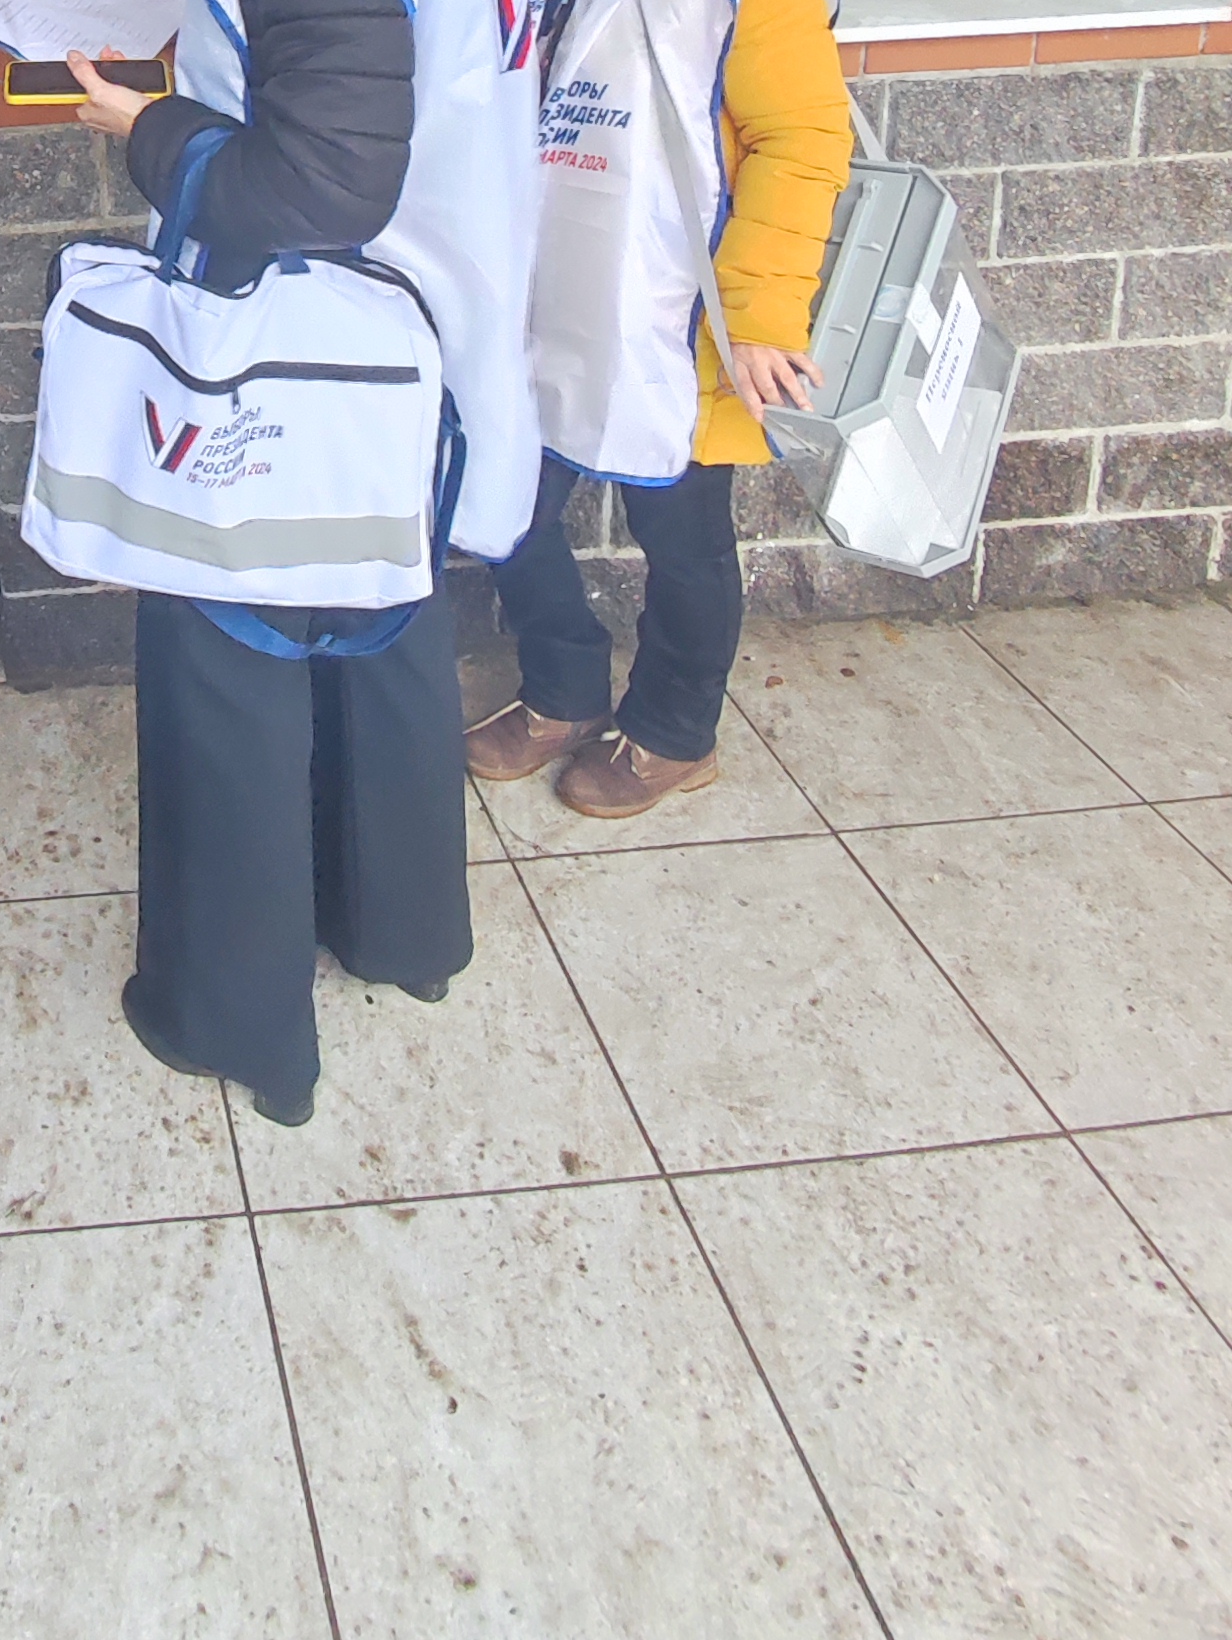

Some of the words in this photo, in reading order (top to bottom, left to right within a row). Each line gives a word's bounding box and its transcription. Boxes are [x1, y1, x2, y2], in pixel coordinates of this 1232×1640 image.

[548, 80, 609, 103] ВОРЫ
[538, 103, 632, 129] ПЗИДЕНТА
[578, 153, 608, 173] 2024
[192, 448, 246, 475] РОСС
